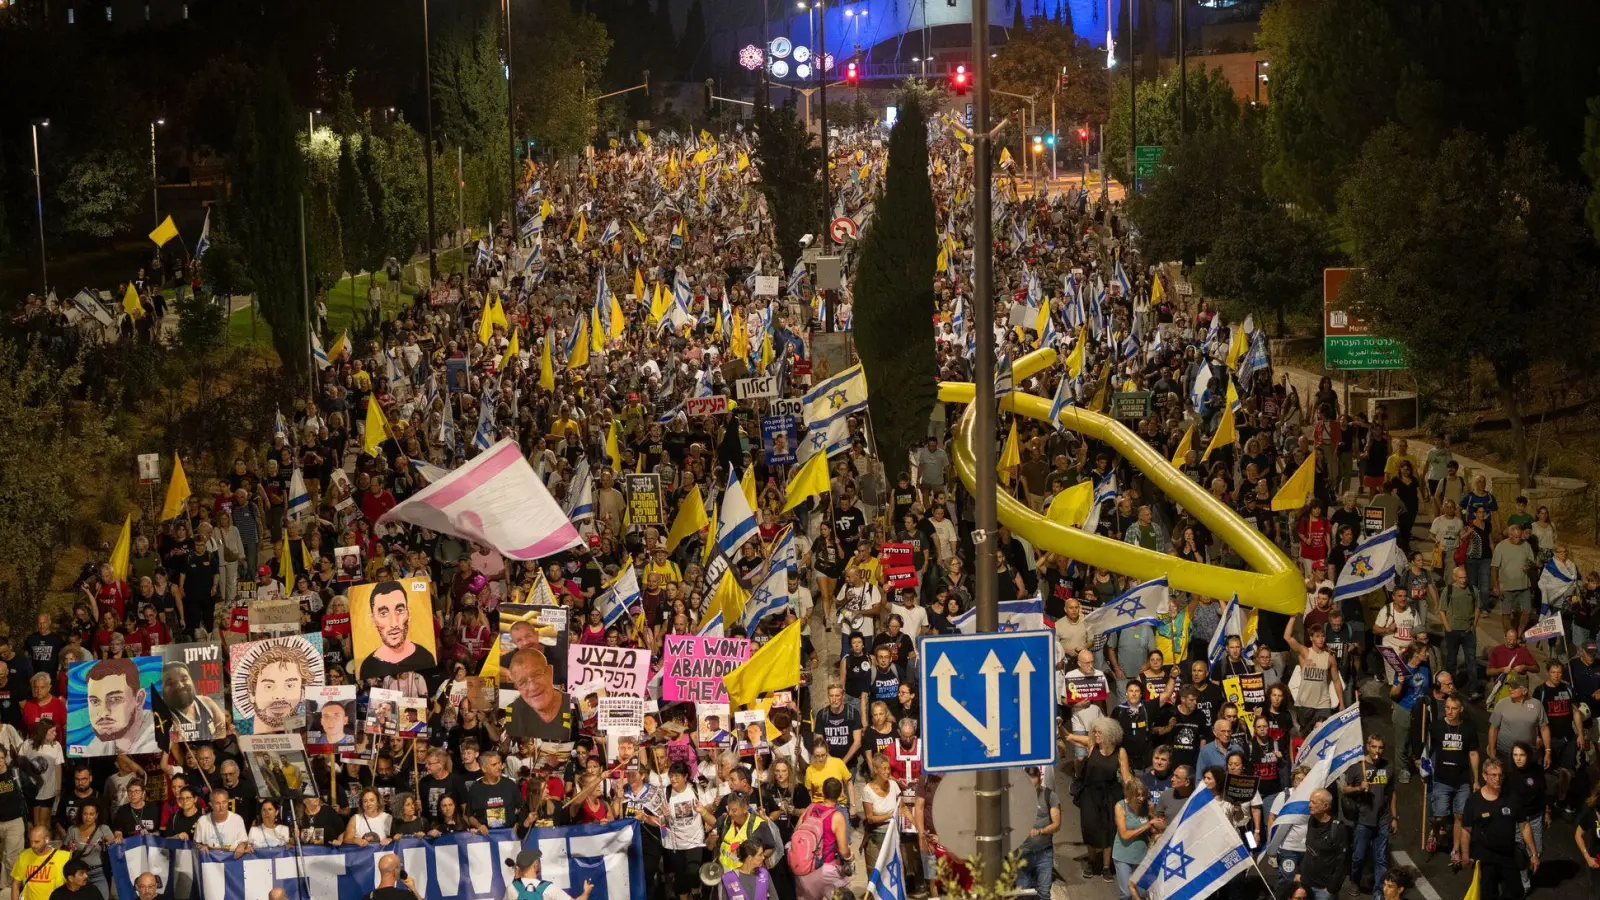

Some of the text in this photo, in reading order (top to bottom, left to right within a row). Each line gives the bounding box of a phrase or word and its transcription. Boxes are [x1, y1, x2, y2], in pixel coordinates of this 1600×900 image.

[184, 644, 218, 664] לאיתן
[667, 639, 695, 656] WE
[577, 647, 637, 669] מבצע
[202, 662, 219, 679] אין
[575, 667, 637, 689] הפקרת
[72, 746, 84, 754] בר
